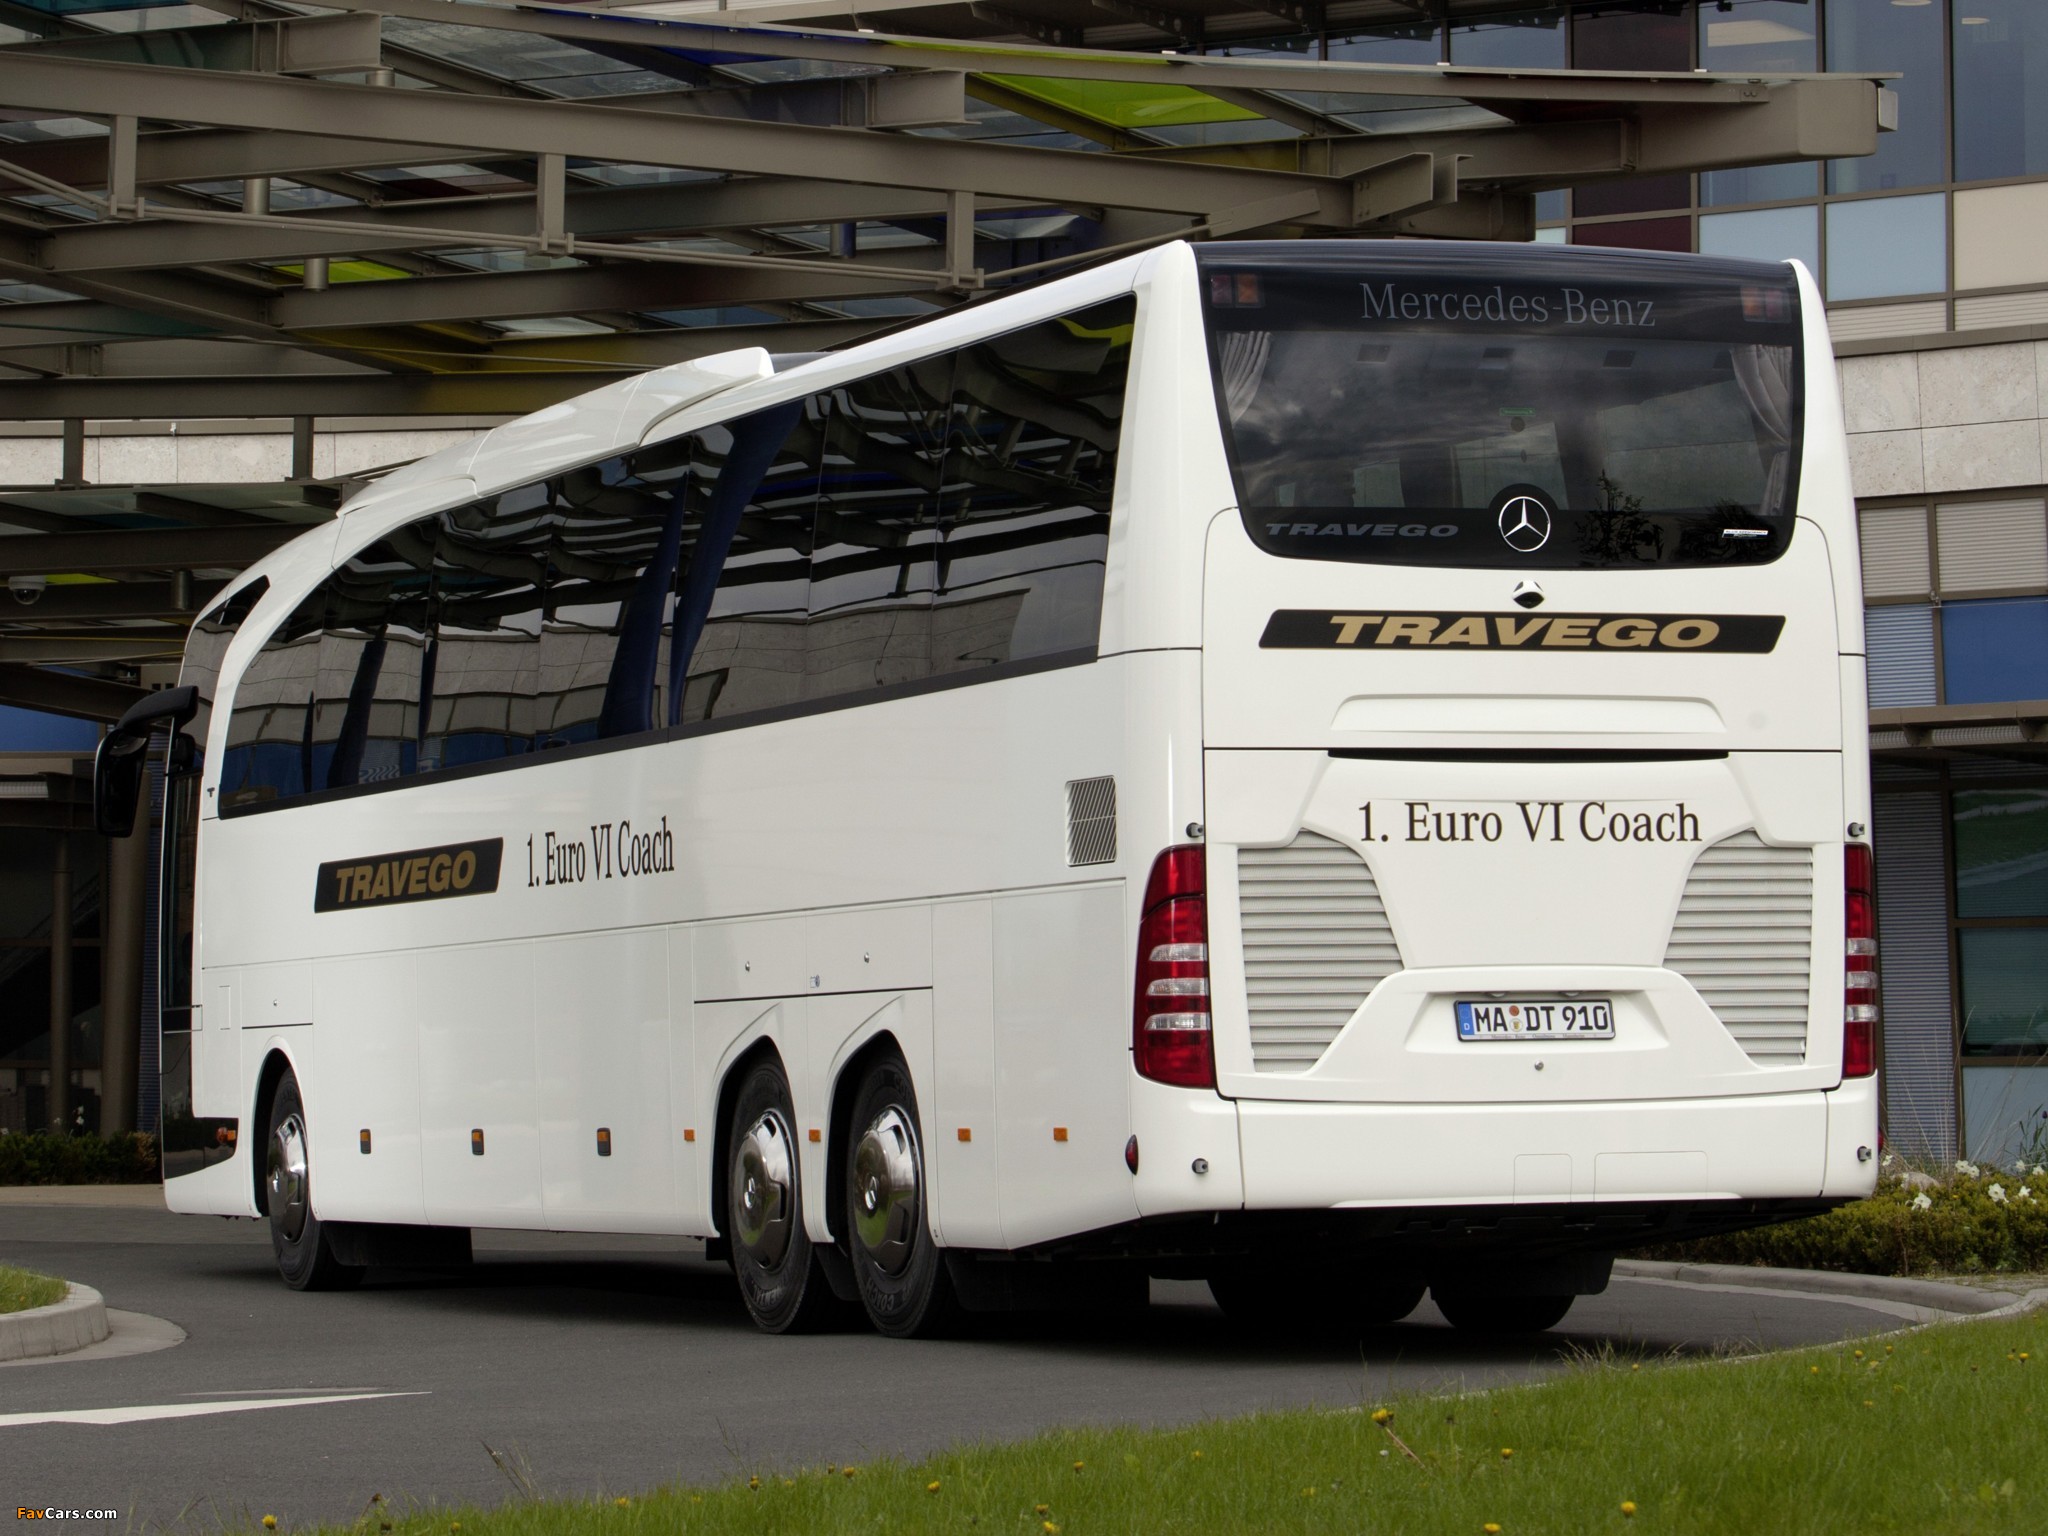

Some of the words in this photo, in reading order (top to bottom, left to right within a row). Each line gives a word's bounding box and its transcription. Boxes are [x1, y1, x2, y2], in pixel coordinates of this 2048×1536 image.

[1359, 282, 1656, 327] Mercedes-Benz
[1265, 523, 1459, 538] TRAVEGO
[1330, 615, 1720, 648] TRAVEGO
[1358, 801, 1389, 842] 1.
[1404, 801, 1503, 842] Euro
[1516, 801, 1566, 842] VI
[1579, 801, 1703, 843] Coach
[527, 832, 540, 888] 1.
[545, 831, 586, 886] Euro
[591, 823, 612, 881] VI
[618, 815, 675, 878] Coach
[336, 850, 476, 903] TRAVEGO
[1474, 1007, 1508, 1032] MA
[1524, 1006, 1555, 1031] DT
[1562, 1005, 1608, 1031] 910
